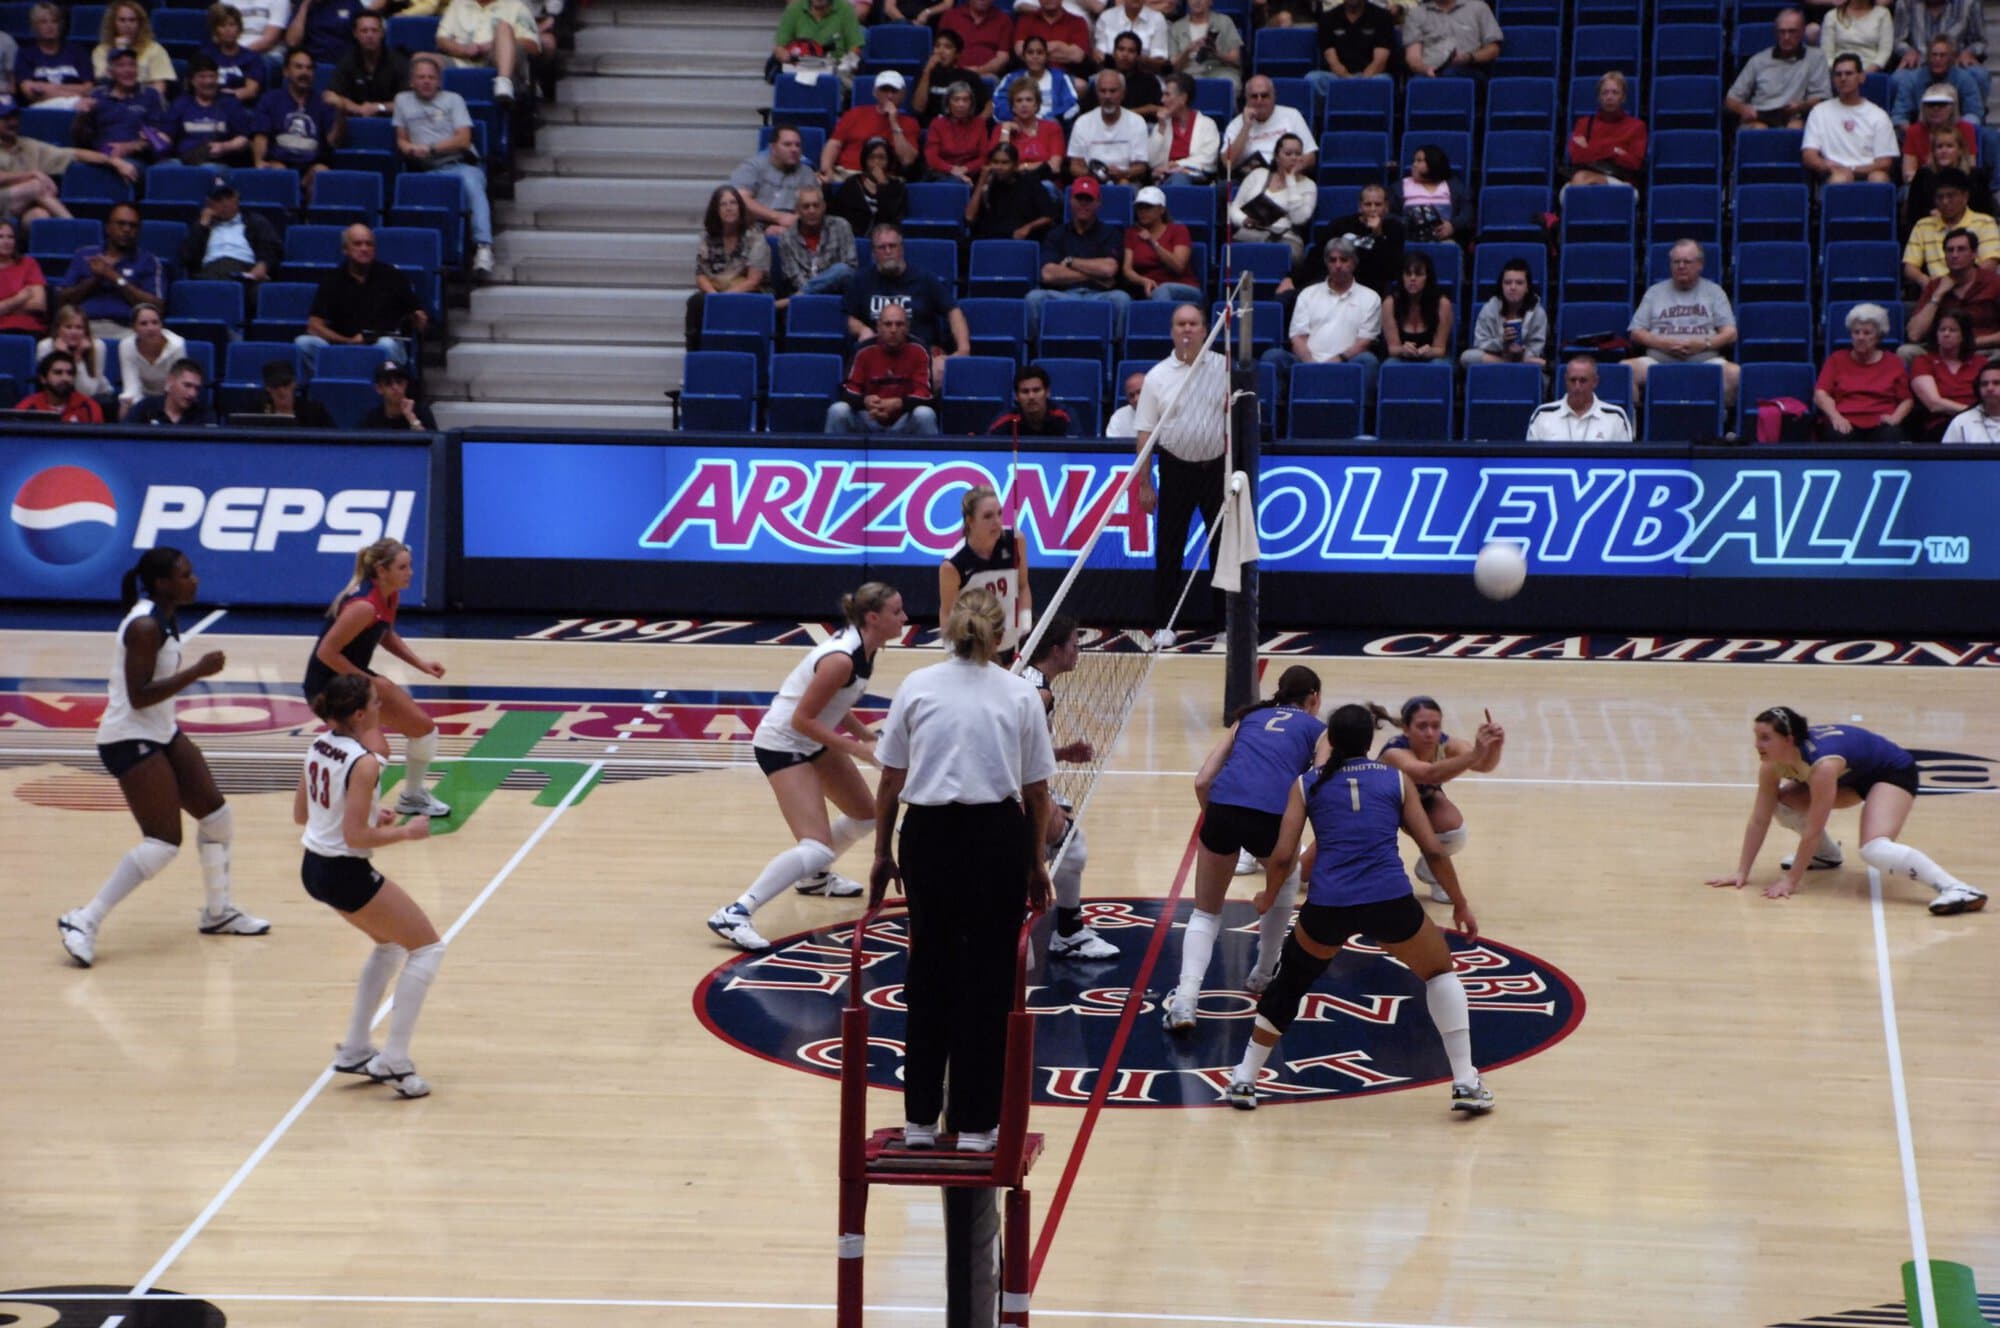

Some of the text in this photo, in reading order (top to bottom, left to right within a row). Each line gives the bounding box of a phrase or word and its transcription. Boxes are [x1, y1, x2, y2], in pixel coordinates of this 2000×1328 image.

[1659, 304, 1709, 319] ARIZONA
[133, 485, 416, 553] PEPSI
[639, 458, 1153, 557] ARIZONA
[1150, 464, 1921, 567] OLLEYBALL
[514, 618, 753, 643] 1997
[1264, 711, 1293, 732] 2
[308, 760, 331, 809] 33
[1346, 777, 1361, 811] 1
[797, 1035, 1413, 1102] CURT
